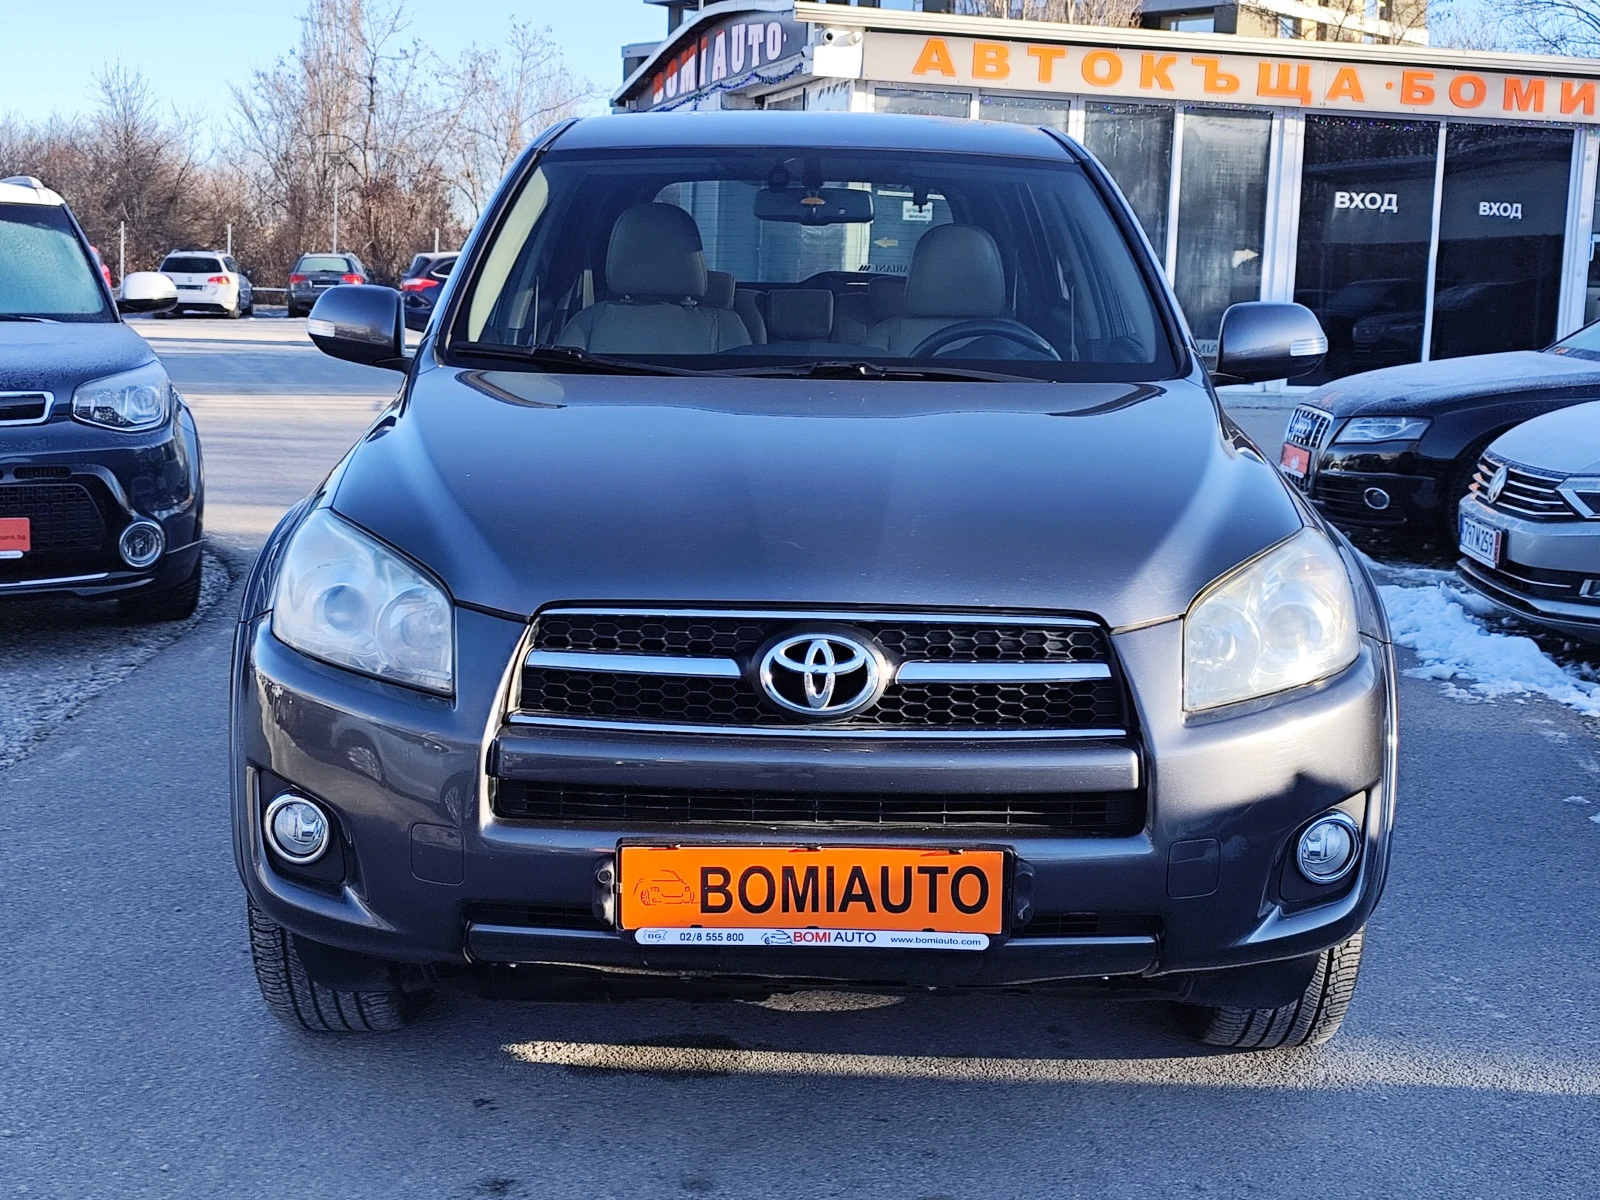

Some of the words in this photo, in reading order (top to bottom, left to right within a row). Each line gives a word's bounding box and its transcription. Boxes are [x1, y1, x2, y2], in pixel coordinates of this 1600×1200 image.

[911, 36, 1366, 106] АВТОКЪЩА
[1400, 68, 1597, 115] БОМИ
[1334, 191, 1398, 213] ВХОД
[1478, 201, 1522, 219] ВХОД
[699, 864, 990, 916] BOMIAUTO
[679, 932, 703, 942] 02/8
[705, 932, 723, 942] 555
[726, 932, 744, 942] 800
[793, 931, 831, 943] BOMI
[834, 932, 877, 943] AUTO
[890, 935, 982, 946] www.bomiauto.com
